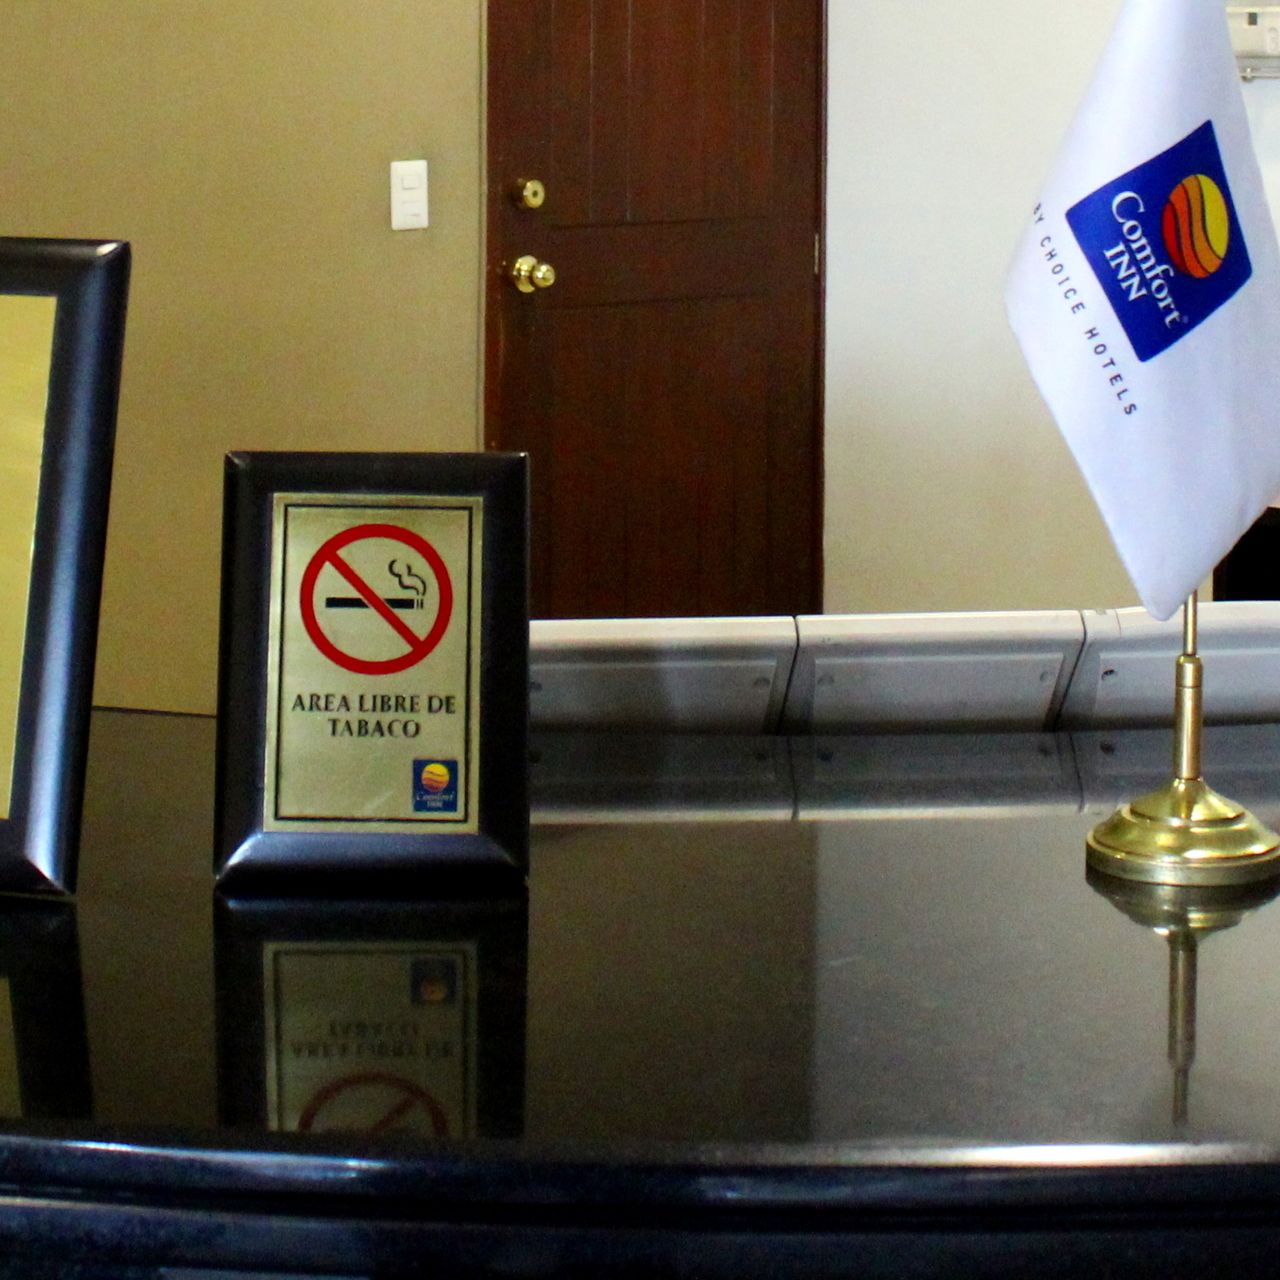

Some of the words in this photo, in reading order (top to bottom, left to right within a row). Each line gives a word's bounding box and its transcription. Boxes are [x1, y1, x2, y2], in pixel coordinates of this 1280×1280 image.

[1103, 241, 1148, 303] INN
[1110, 190, 1182, 329] Comfort
[1039, 235, 1086, 315] CHOICE
[1083, 326, 1138, 416] HOTELS
[291, 693, 351, 713] AREA
[358, 694, 421, 714] LIBRE
[427, 695, 457, 715] DE
[328, 718, 421, 739] TABACO
